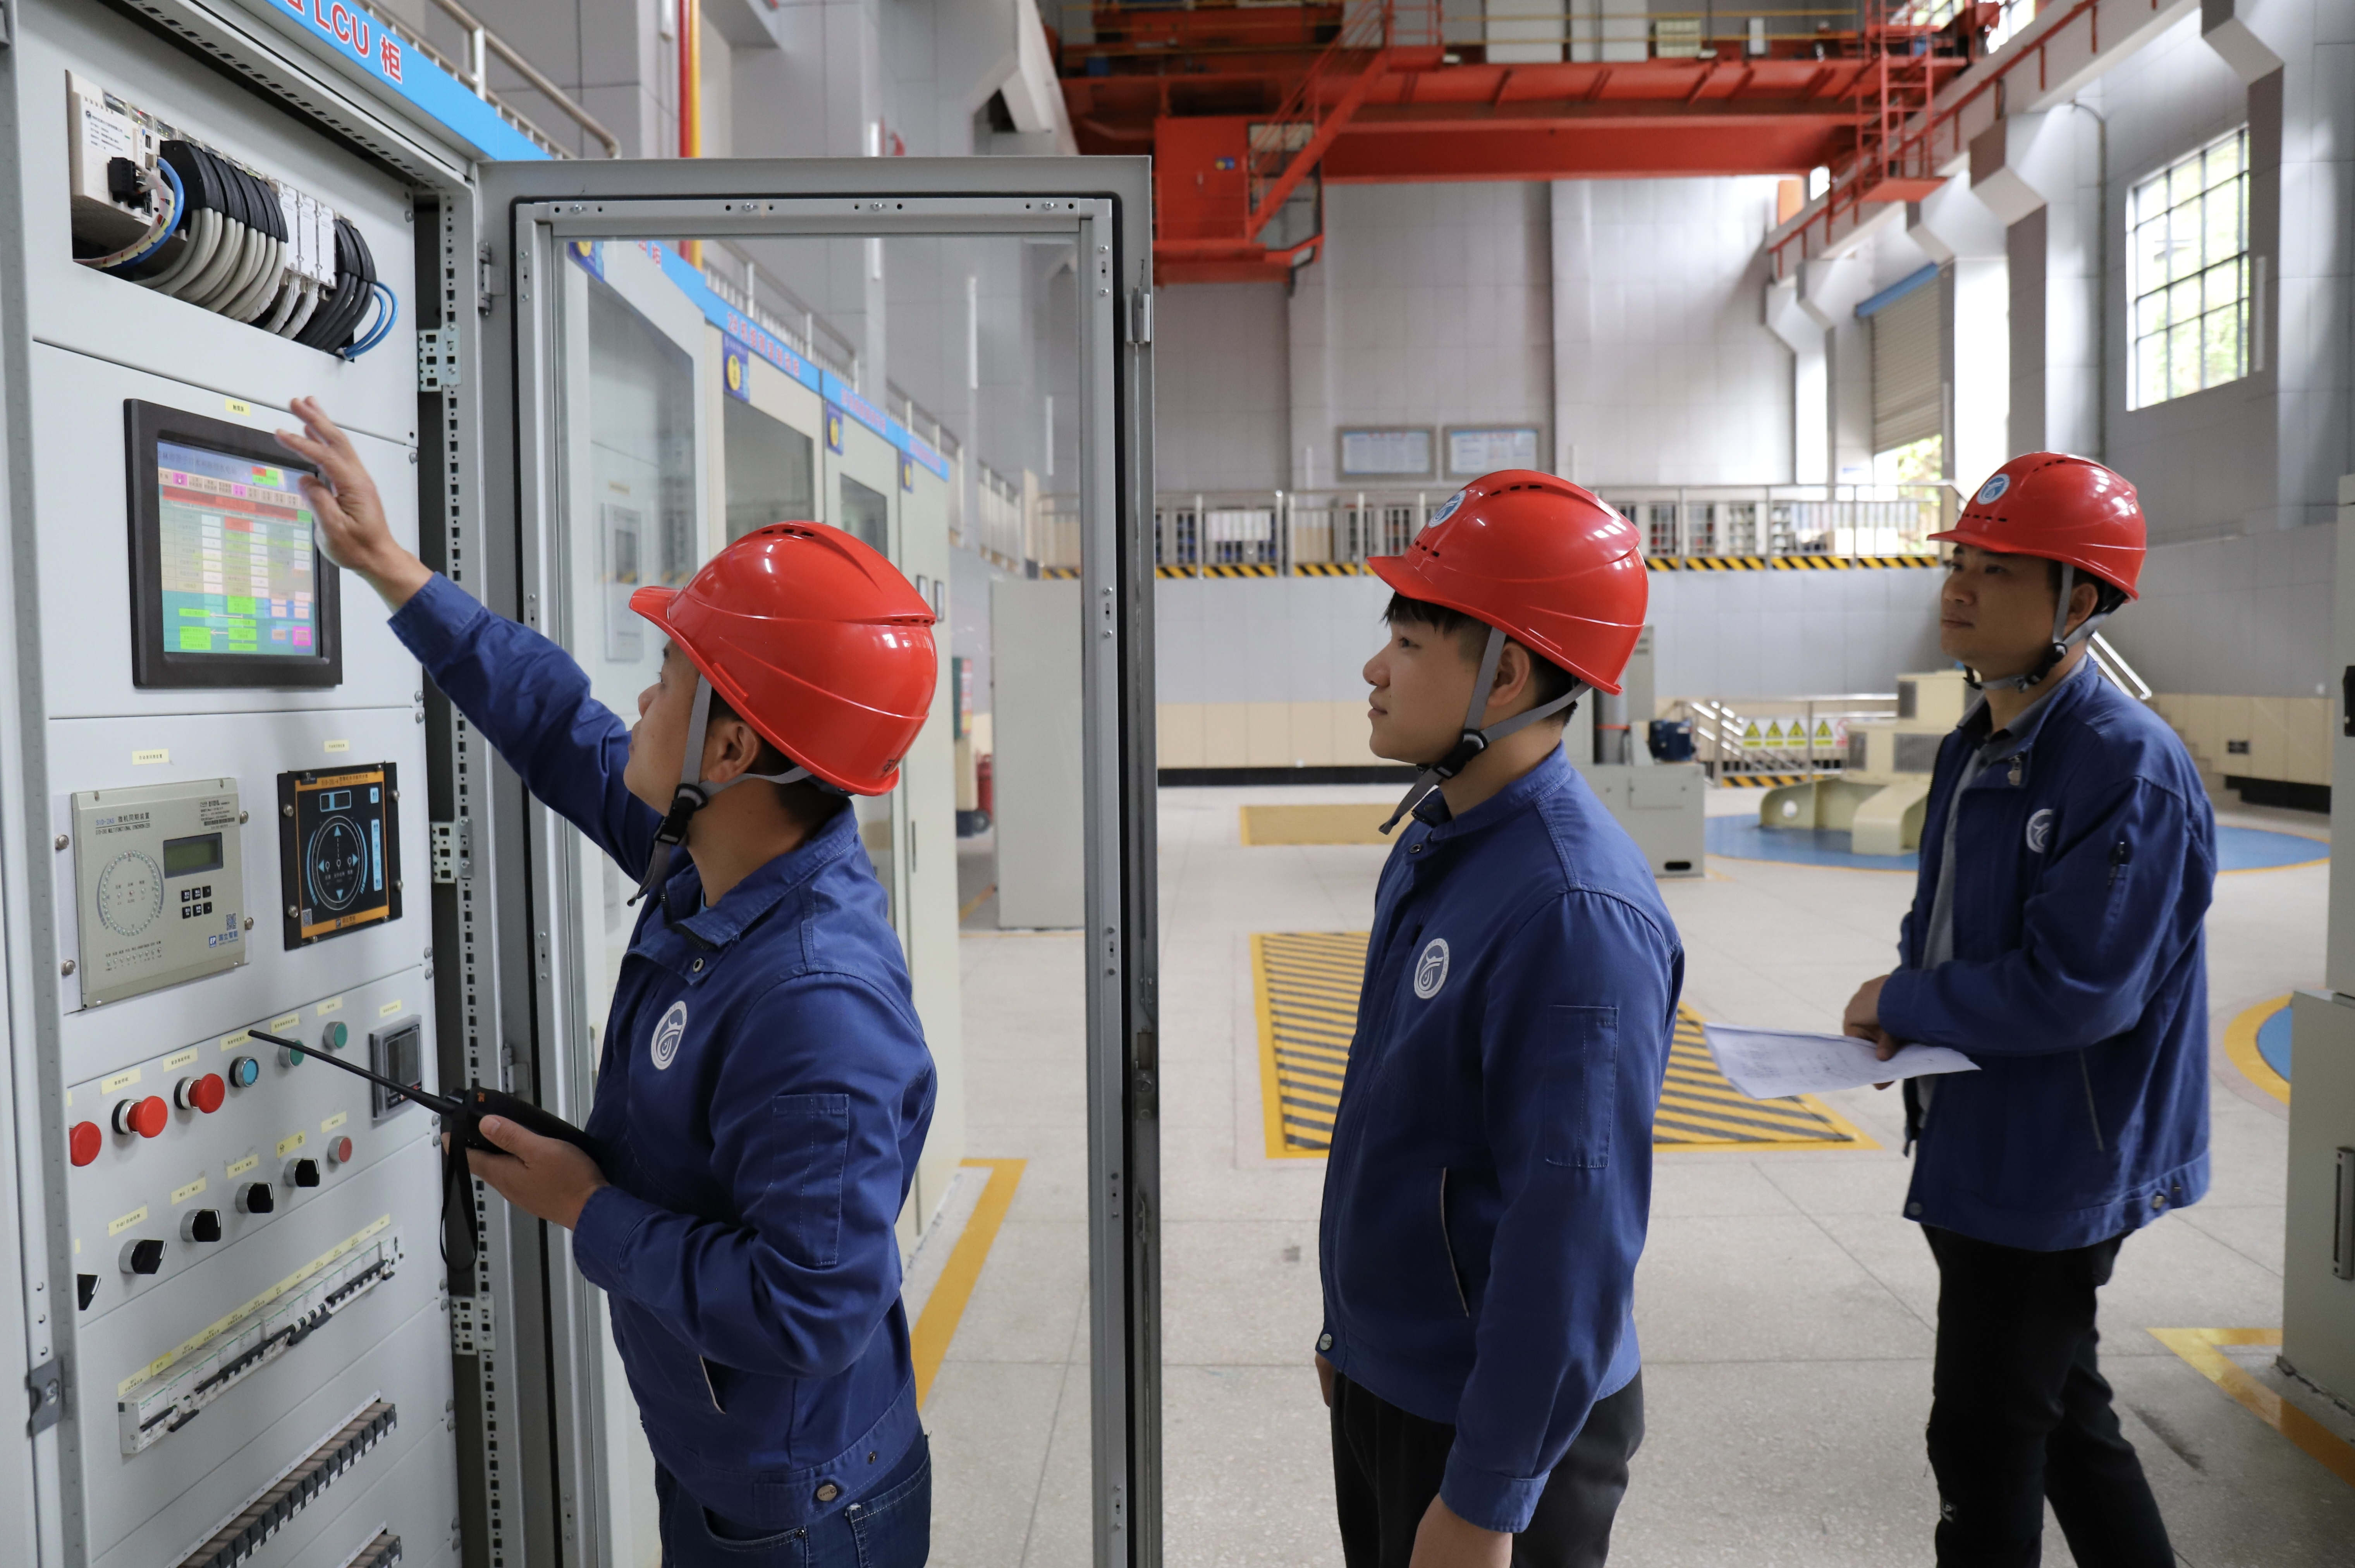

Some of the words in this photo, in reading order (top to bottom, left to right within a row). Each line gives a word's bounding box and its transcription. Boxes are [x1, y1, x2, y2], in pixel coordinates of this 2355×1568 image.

[313, 0, 370, 58] LCU
[379, 33, 402, 84] 柜
[118, 812, 150, 823] 微机同期装置
[279, 1143, 285, 1153] 分
[297, 1135, 303, 1143] 合
